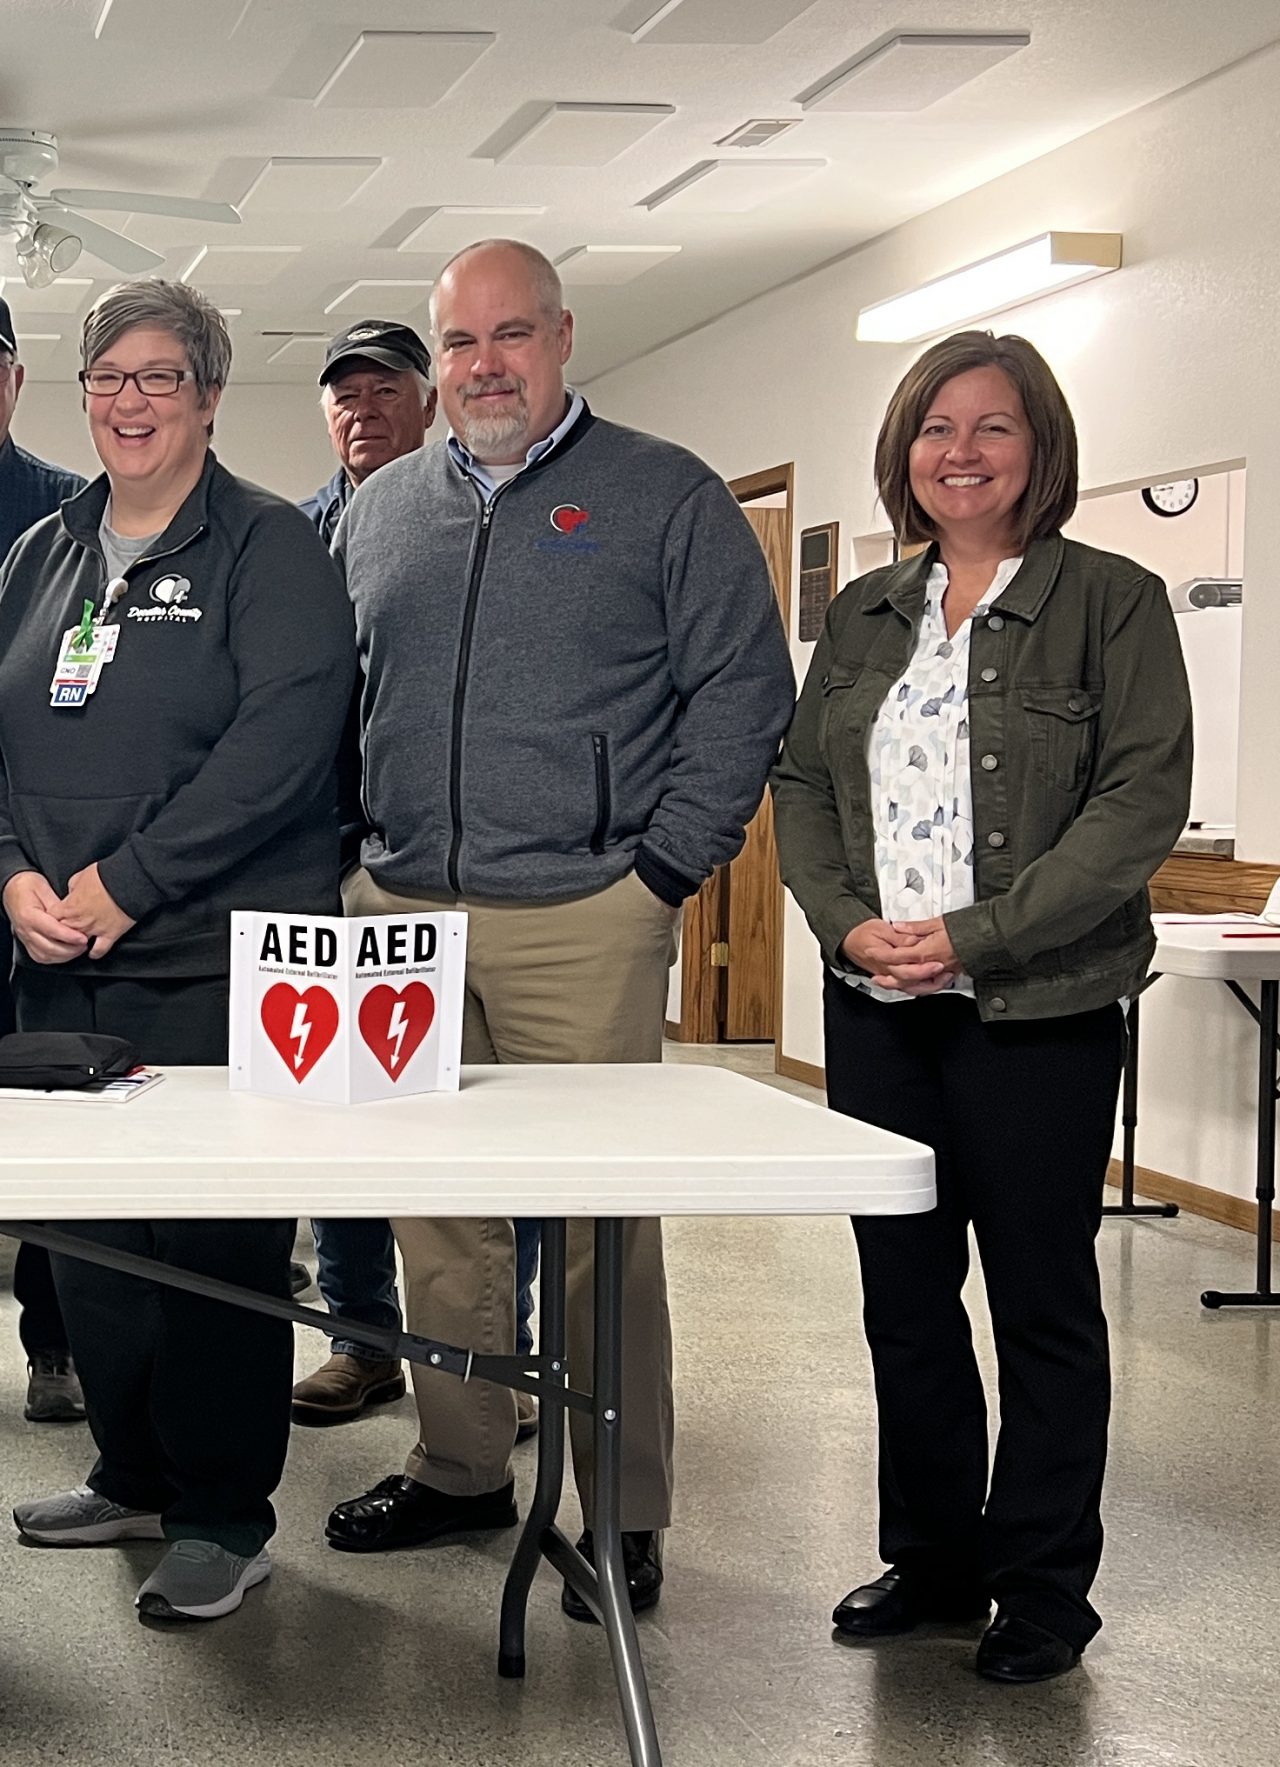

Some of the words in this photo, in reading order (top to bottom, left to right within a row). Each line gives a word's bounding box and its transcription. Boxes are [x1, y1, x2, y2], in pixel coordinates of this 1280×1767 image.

[58, 687, 82, 701] RN
[260, 923, 337, 967] AED
[356, 924, 437, 967] AED
